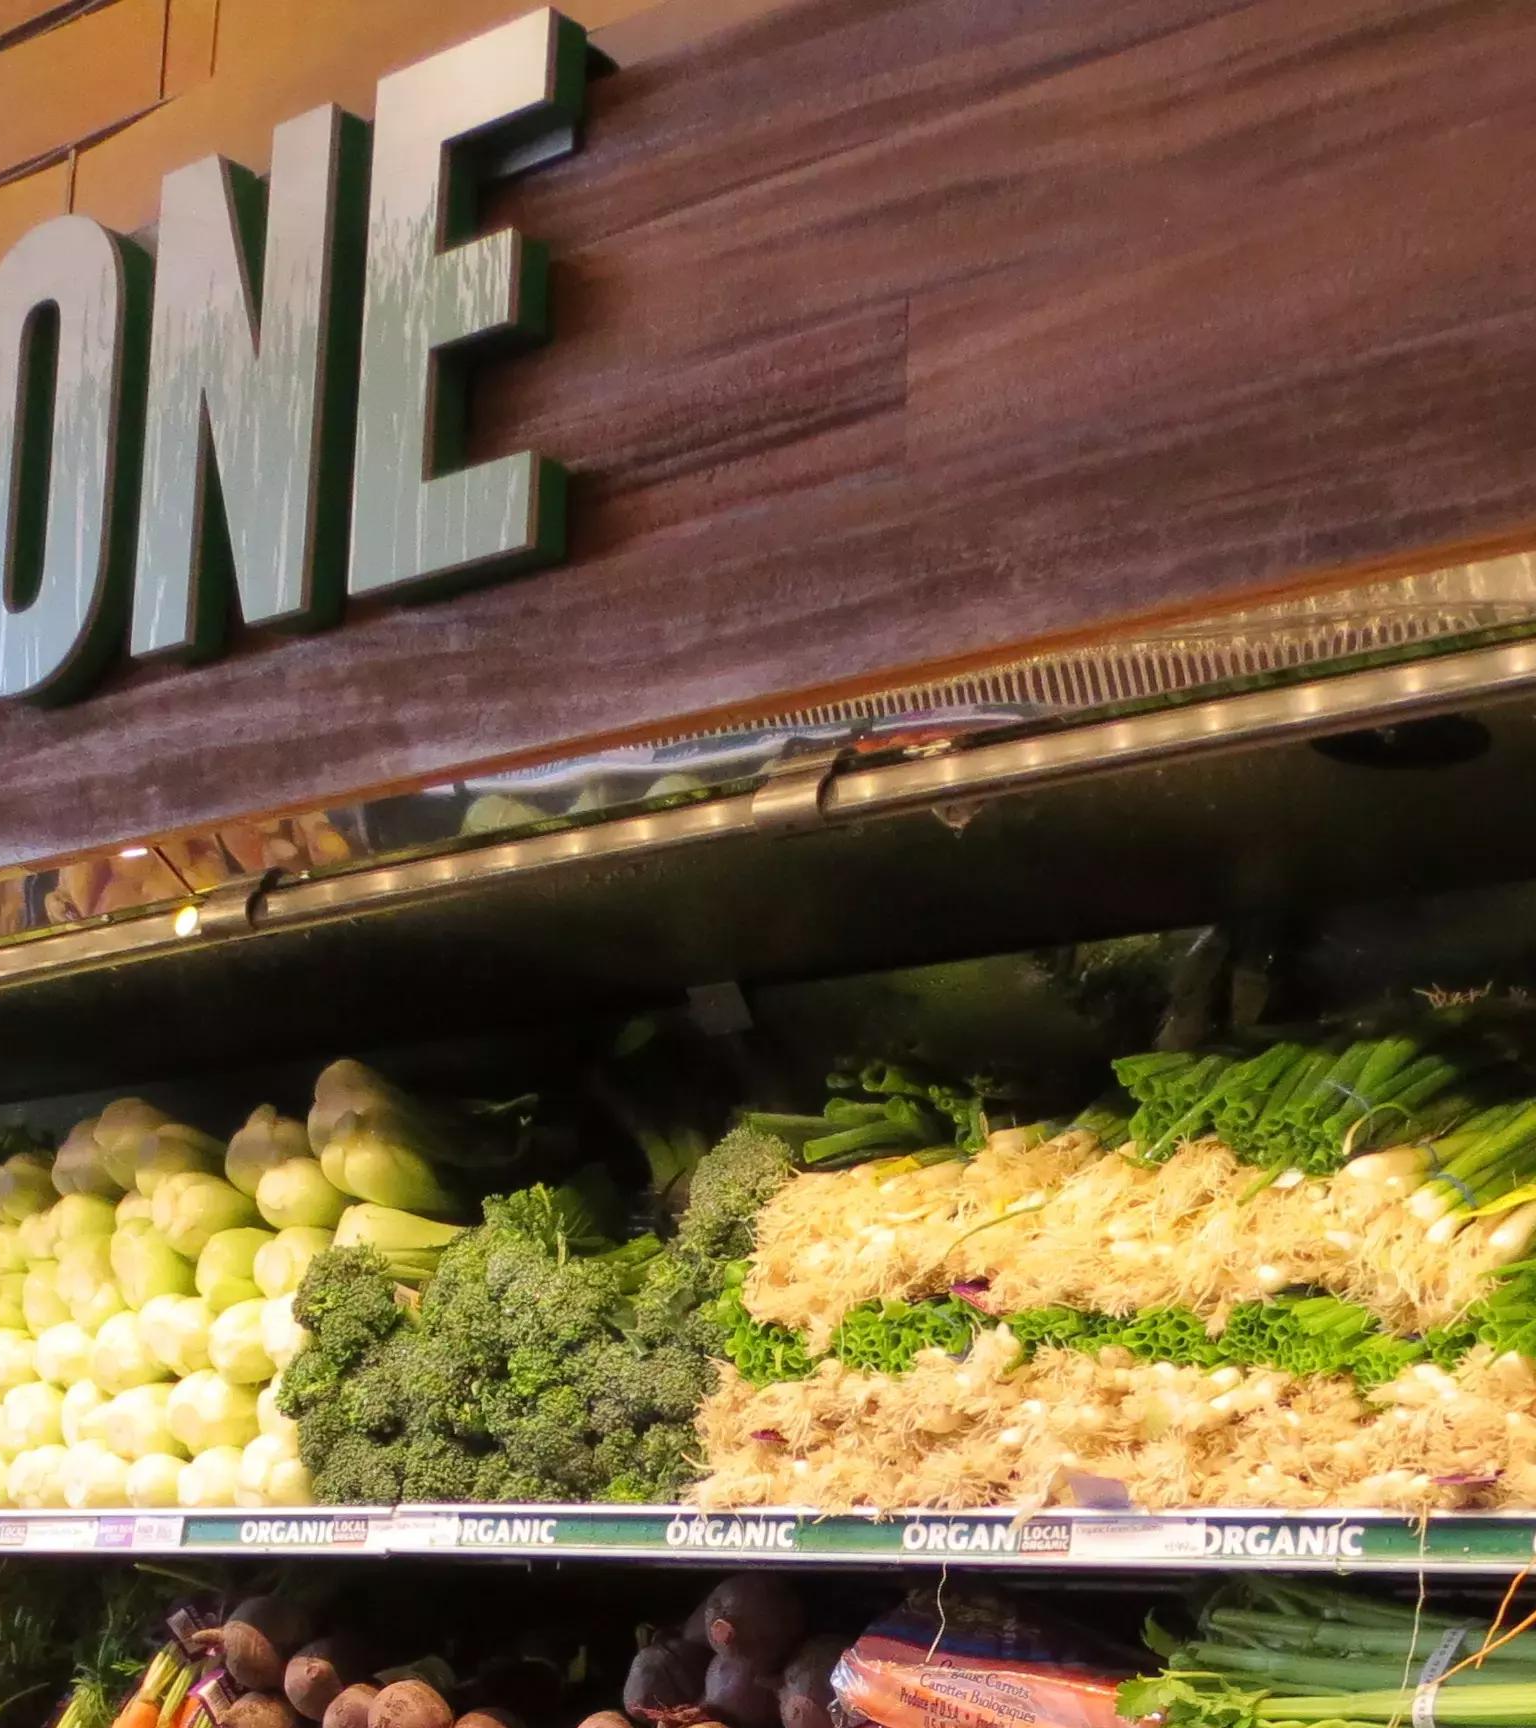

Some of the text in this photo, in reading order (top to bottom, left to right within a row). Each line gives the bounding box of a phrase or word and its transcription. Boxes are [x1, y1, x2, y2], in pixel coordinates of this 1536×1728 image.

[335, 1520, 367, 1533] LOCAL
[457, 1518, 558, 1545] RGANIC
[666, 1519, 797, 1549] ORGANIC
[902, 1522, 1019, 1552] ORGAN
[1022, 1524, 1069, 1542] LOCAL
[1021, 1540, 1069, 1551] ORGANIC
[919, 1672, 1036, 1724] Carottes Biologiques
[985, 1672, 1030, 1699] Carrots
